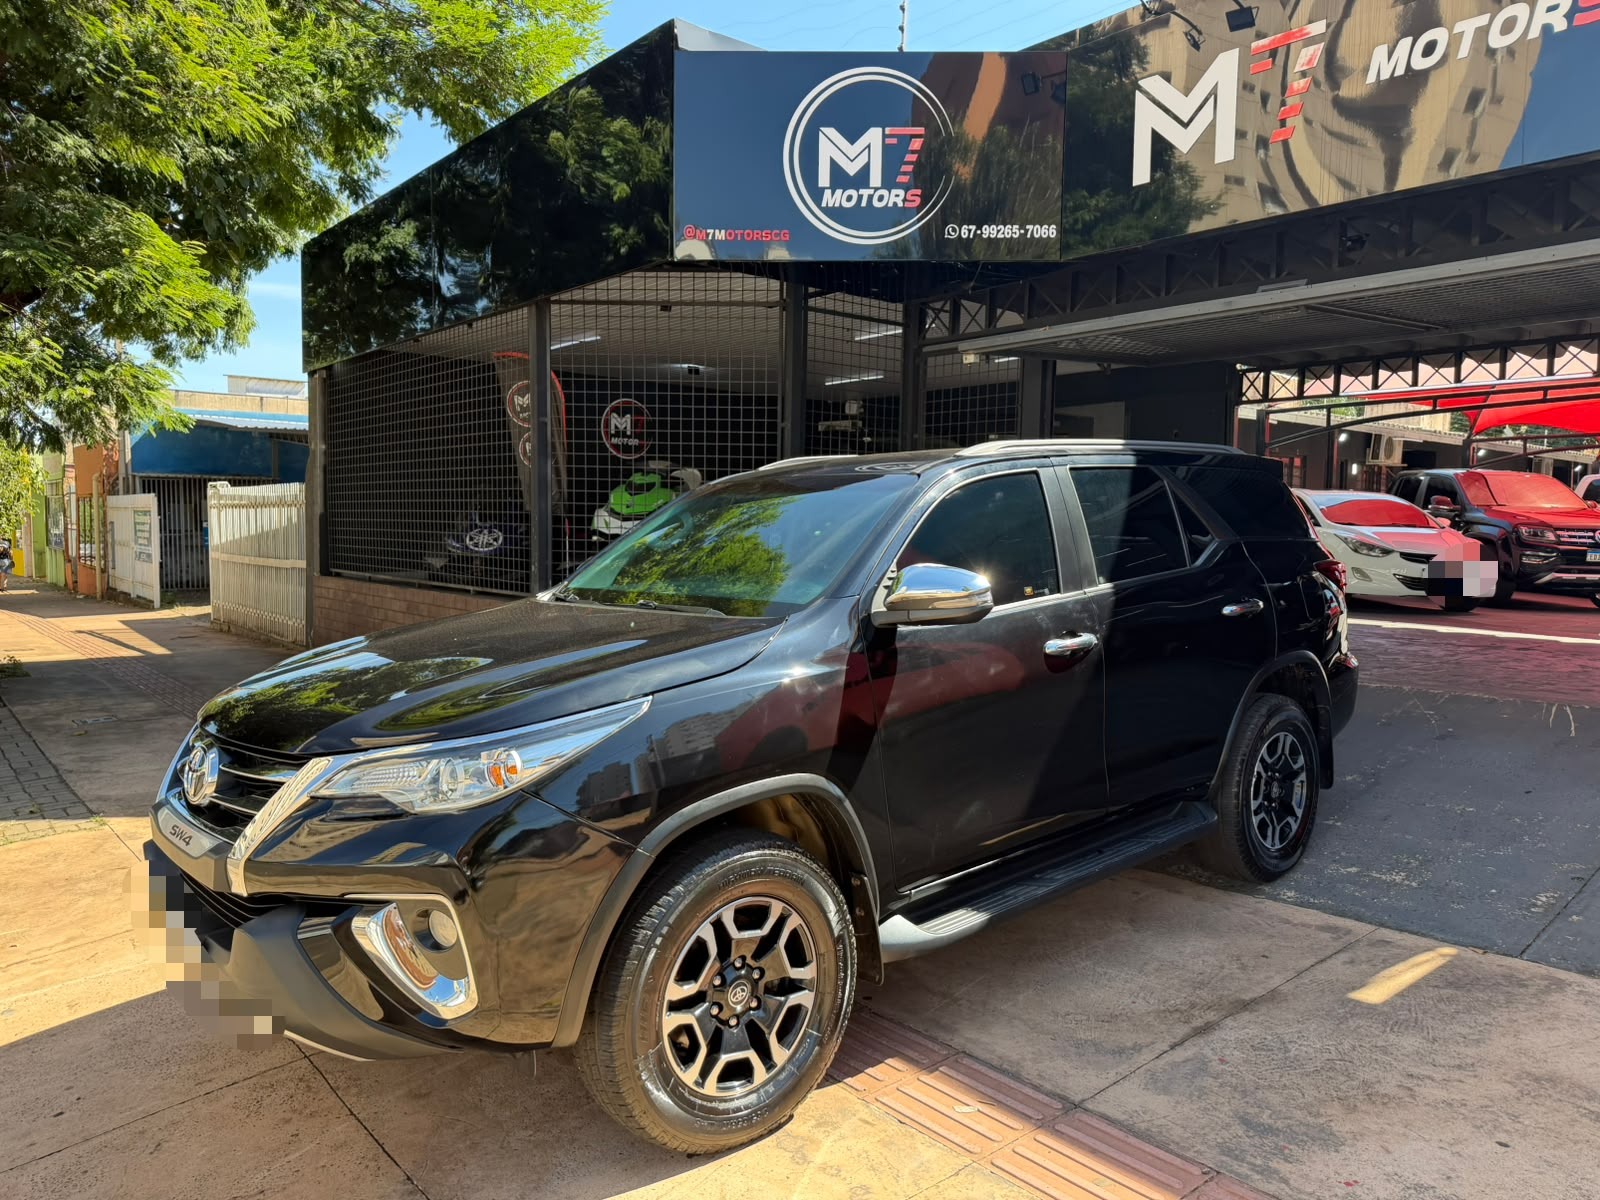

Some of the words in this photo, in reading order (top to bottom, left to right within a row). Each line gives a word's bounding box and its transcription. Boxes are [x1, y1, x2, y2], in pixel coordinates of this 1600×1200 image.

[1132, 19, 1327, 187] M7
[817, 127, 925, 187] M7
[821, 188, 922, 208] MOTORS
[683, 224, 790, 241] @M7MOTORSCG
[960, 224, 1057, 239] 67-99265-7066
[611, 437, 642, 446] MOTOR
[169, 825, 192, 846] SW4
